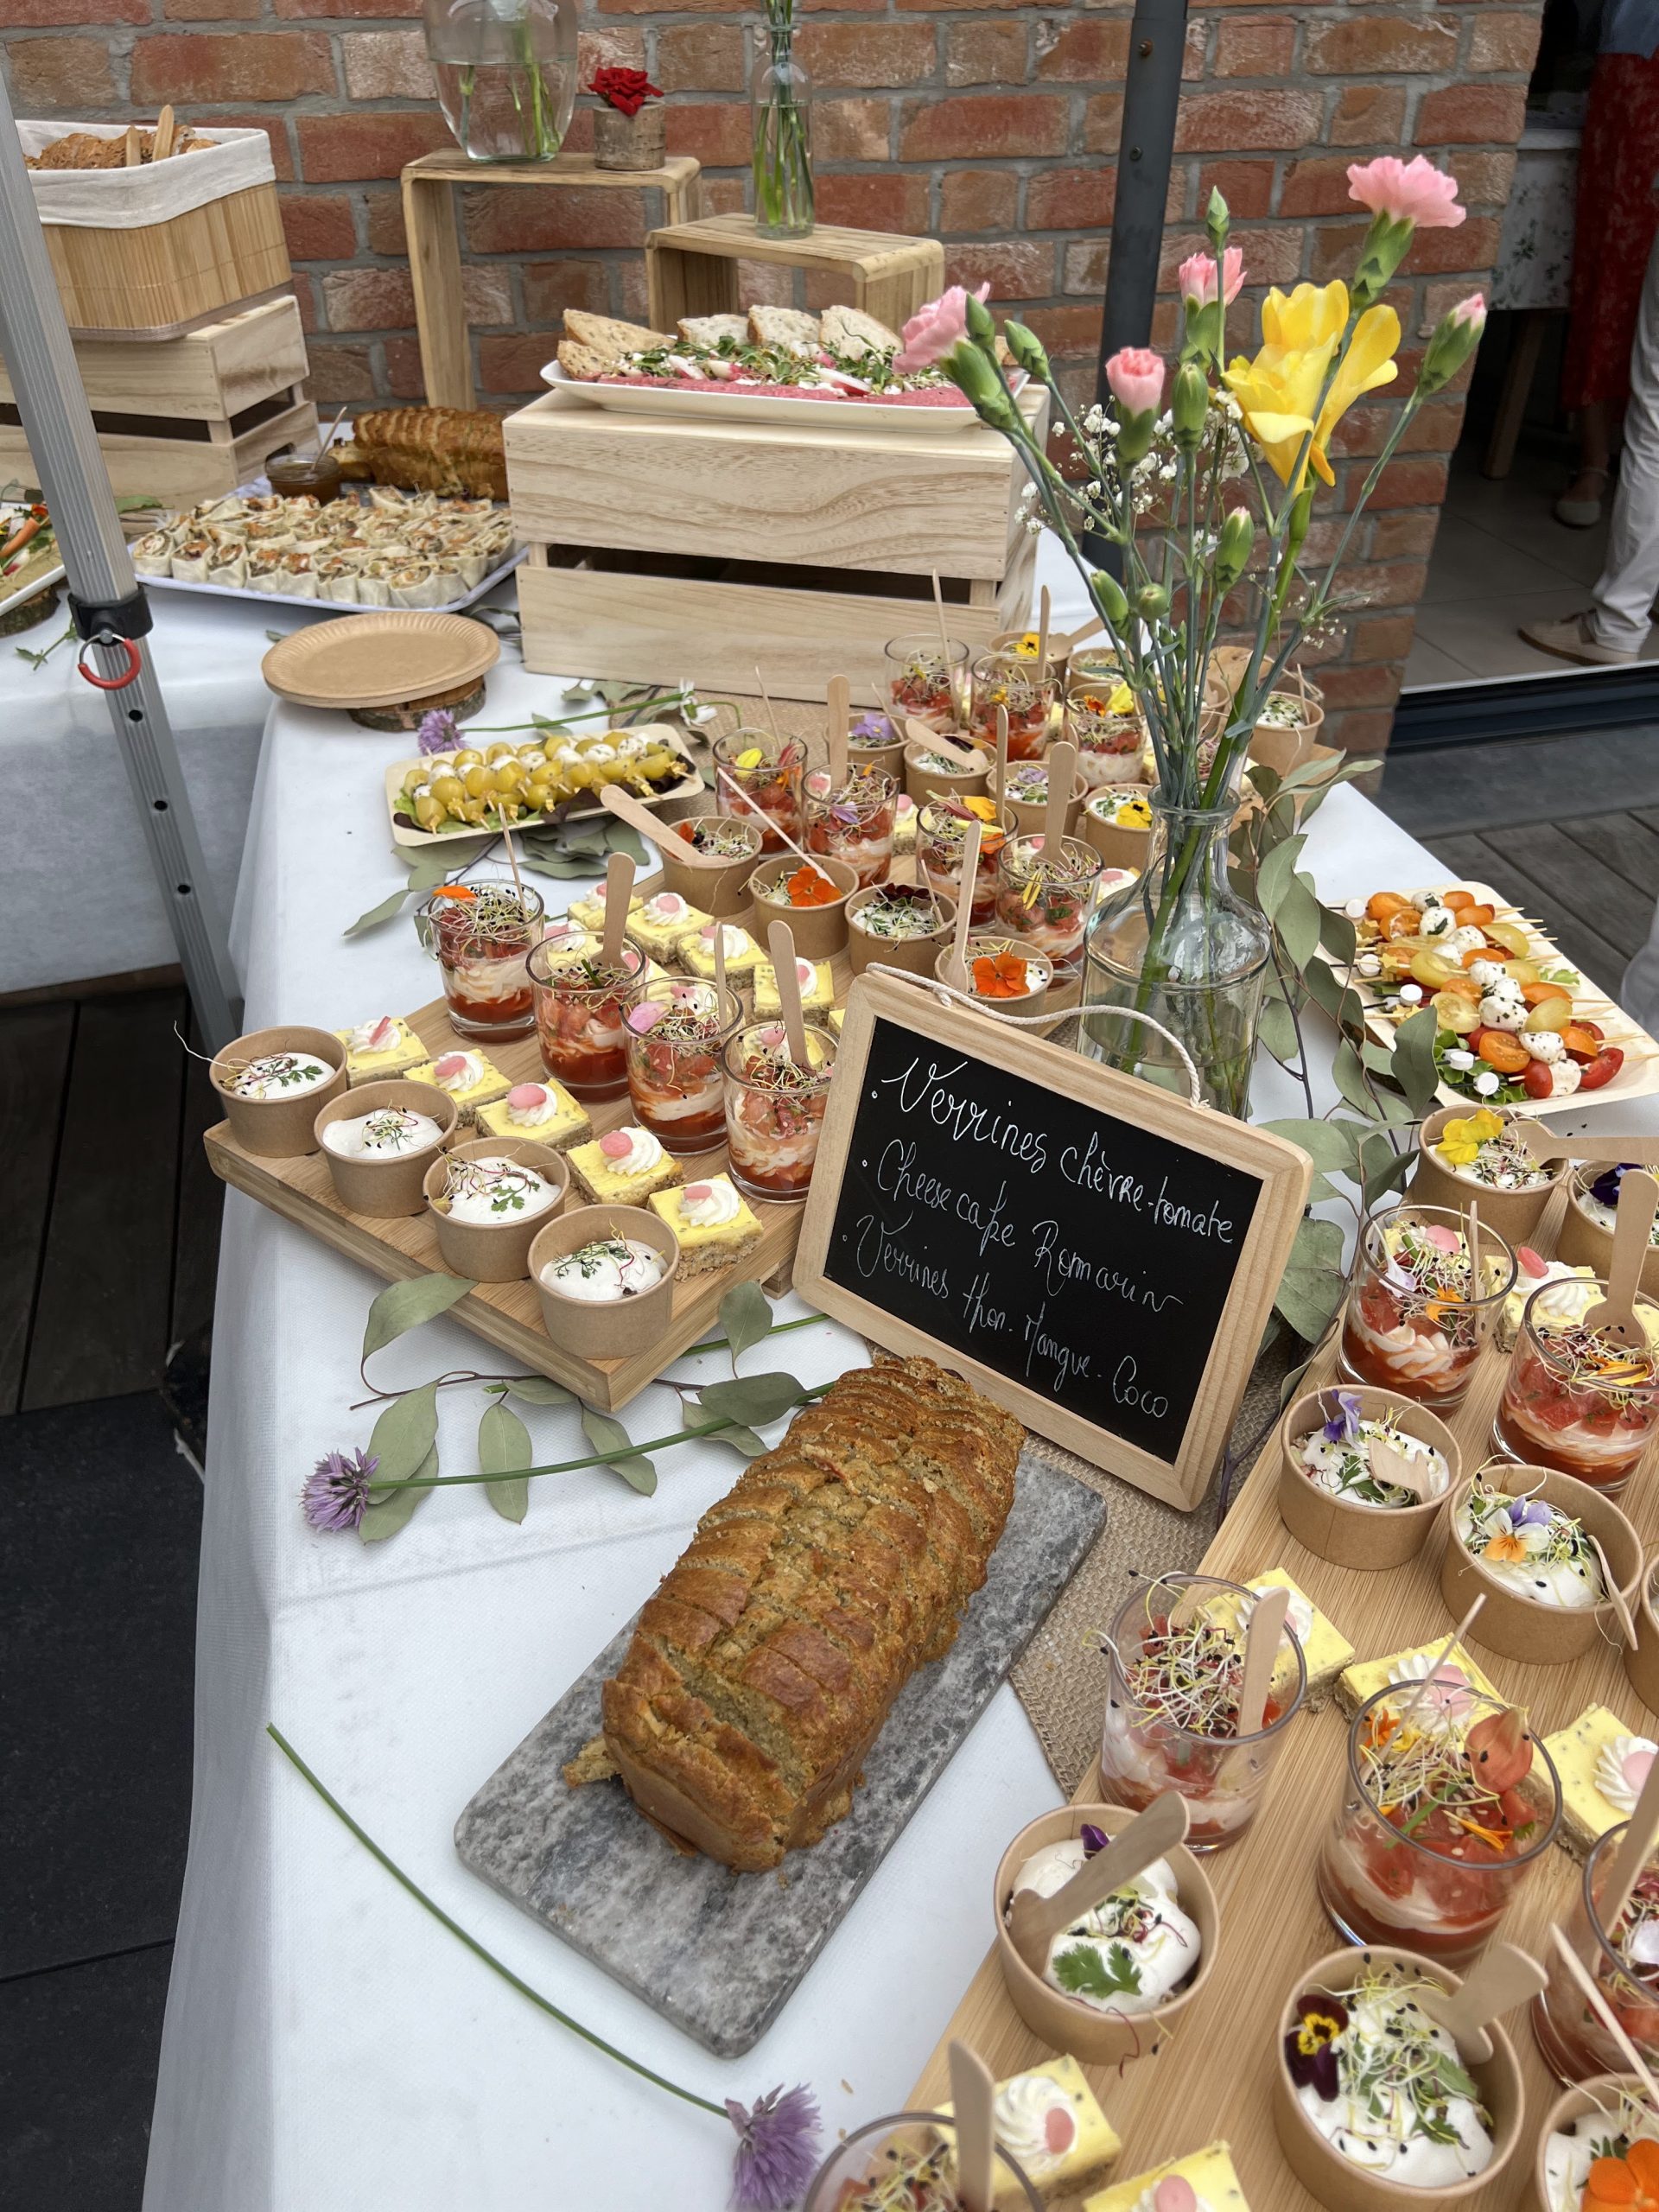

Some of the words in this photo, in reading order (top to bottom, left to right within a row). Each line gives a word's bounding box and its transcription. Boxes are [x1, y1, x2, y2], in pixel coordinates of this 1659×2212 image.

[881, 1057, 1048, 1173] Verrines
[856, 1210, 949, 1299] Verrines
[1112, 1355, 1168, 1418] Coco
[1032, 1220, 1184, 1313] Romarin
